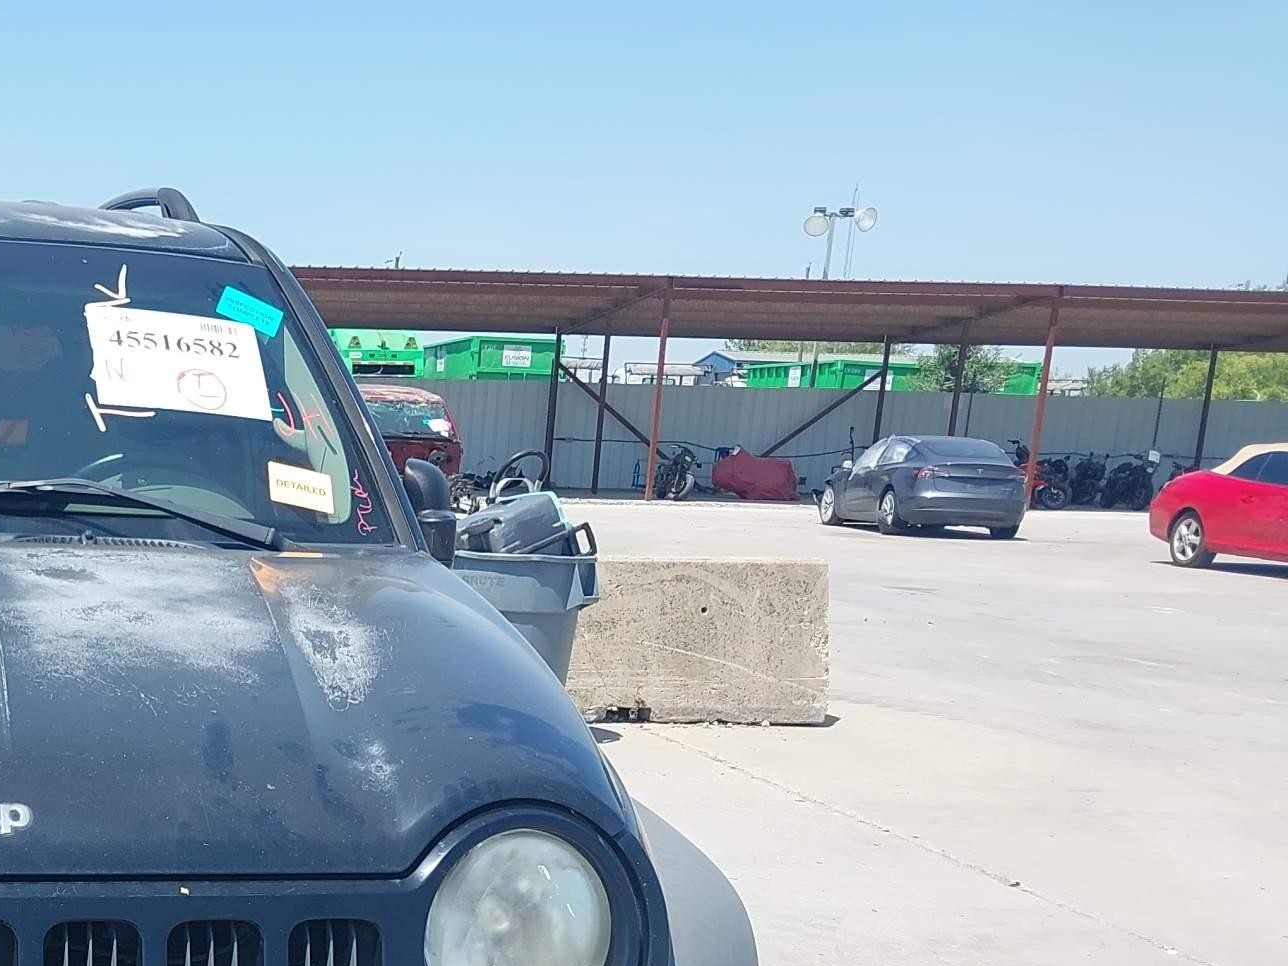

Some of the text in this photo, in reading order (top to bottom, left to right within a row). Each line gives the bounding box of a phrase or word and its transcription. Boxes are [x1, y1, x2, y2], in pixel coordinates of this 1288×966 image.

[224, 296, 275, 321] INSPECTION
[227, 303, 270, 325] COMPLETE
[109, 329, 241, 359] 45516582
[275, 478, 326, 497] DETAILED
